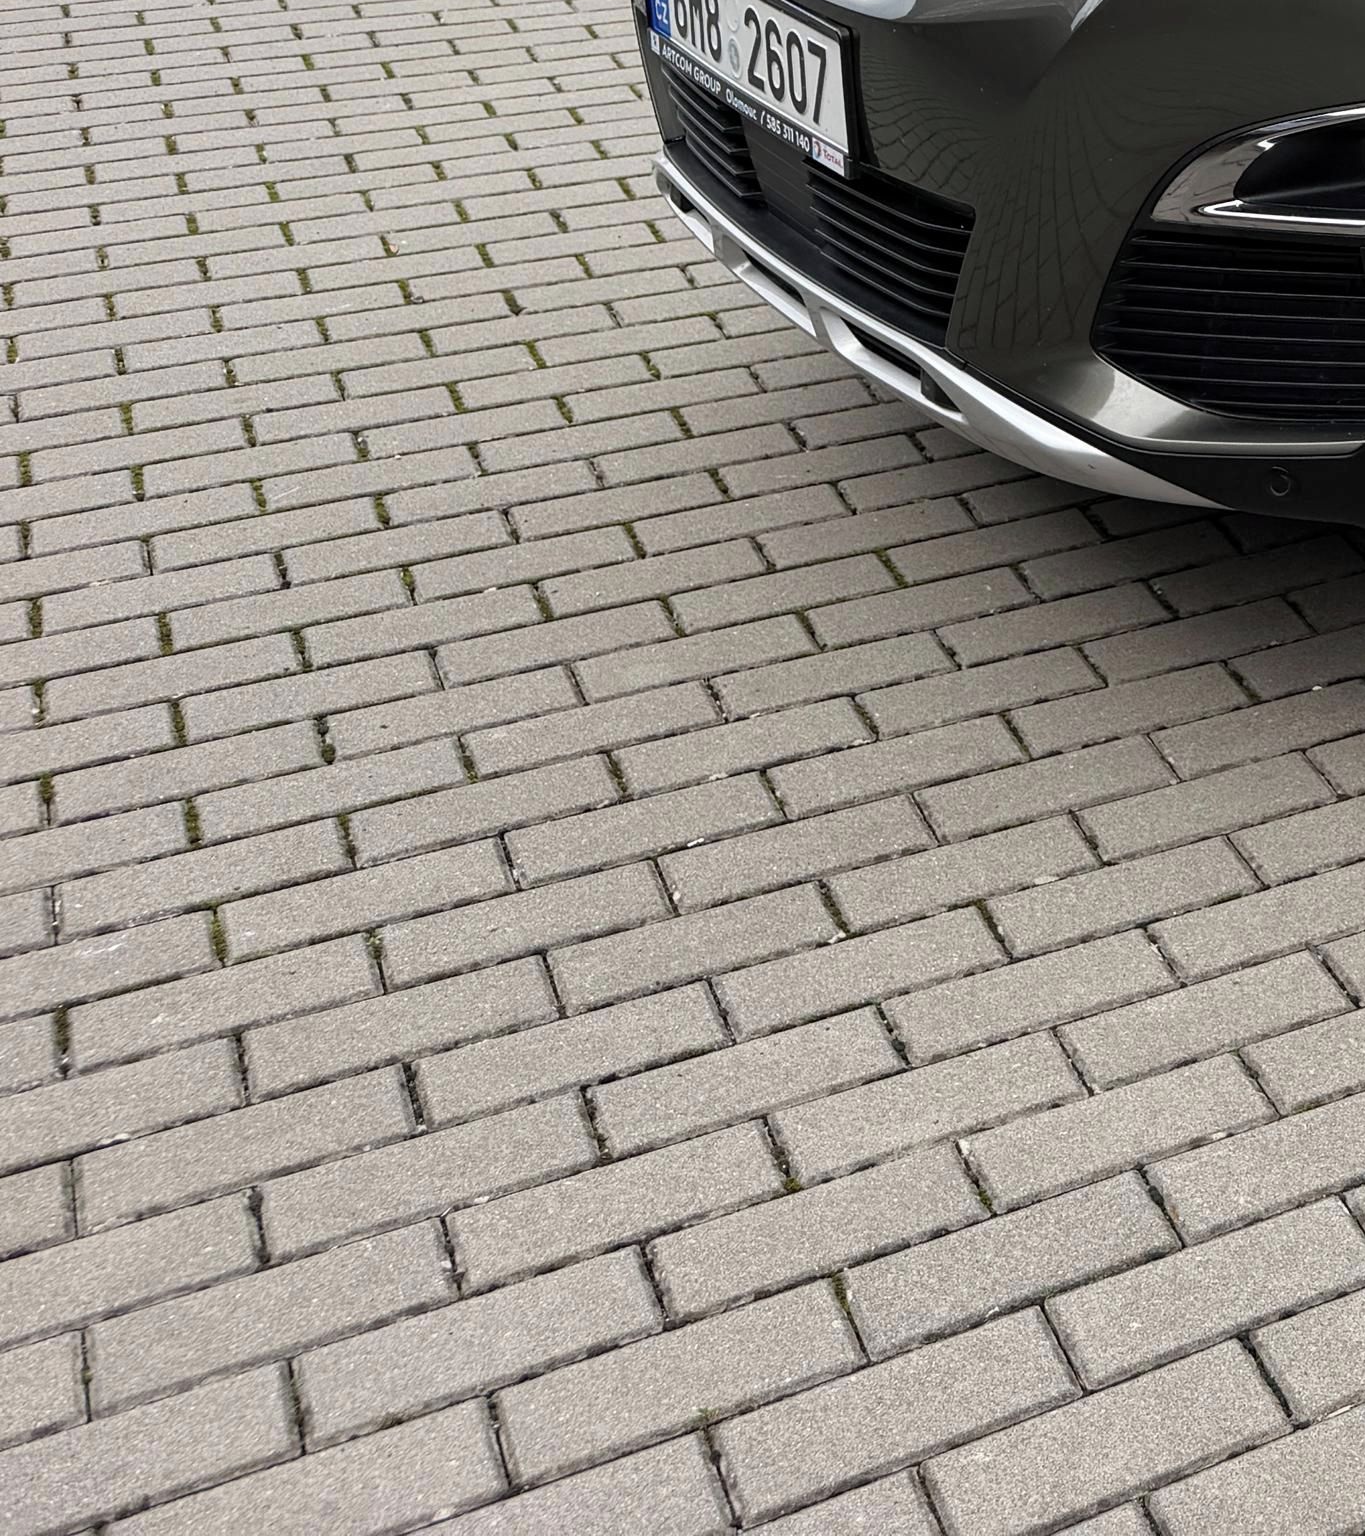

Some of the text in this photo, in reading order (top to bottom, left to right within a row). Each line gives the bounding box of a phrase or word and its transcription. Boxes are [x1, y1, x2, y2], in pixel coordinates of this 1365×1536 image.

[661, 43, 693, 76] ARTCOM
[693, 66, 721, 96] GROUP
[725, 88, 758, 121] Olomouc
[766, 113, 782, 136] 585
[795, 131, 810, 152] 140
[744, 5, 828, 126] 2607
